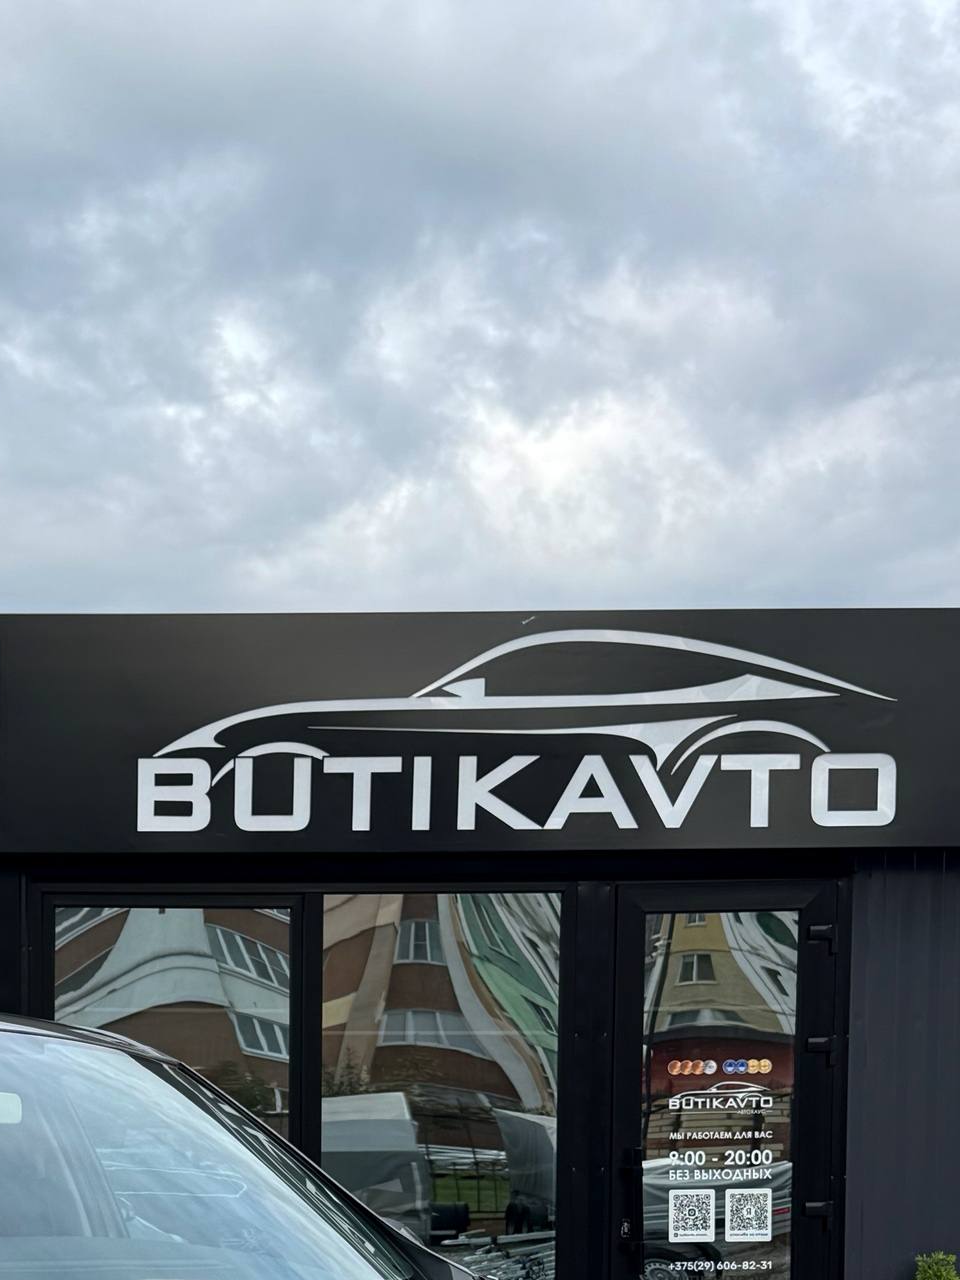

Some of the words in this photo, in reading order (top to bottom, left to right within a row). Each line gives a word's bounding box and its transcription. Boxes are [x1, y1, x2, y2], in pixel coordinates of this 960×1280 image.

[136, 752, 898, 832] BUTIKAVTO
[668, 1096, 773, 1109] BUTIKAVTO
[669, 1132, 685, 1140] МЫ
[686, 1131, 733, 1140] РАБОТАЕМ
[734, 1131, 753, 1140] ДЛЯ
[754, 1131, 774, 1139] ВАС
[669, 1150, 706, 1166] 9:00
[724, 1149, 773, 1166] 20:00
[669, 1169, 690, 1181] БЕЗ
[694, 1168, 773, 1181] ВЫХОДНЫХ
[668, 1261, 714, 1271] +375(29)
[716, 1260, 773, 1270] 606-82-31
